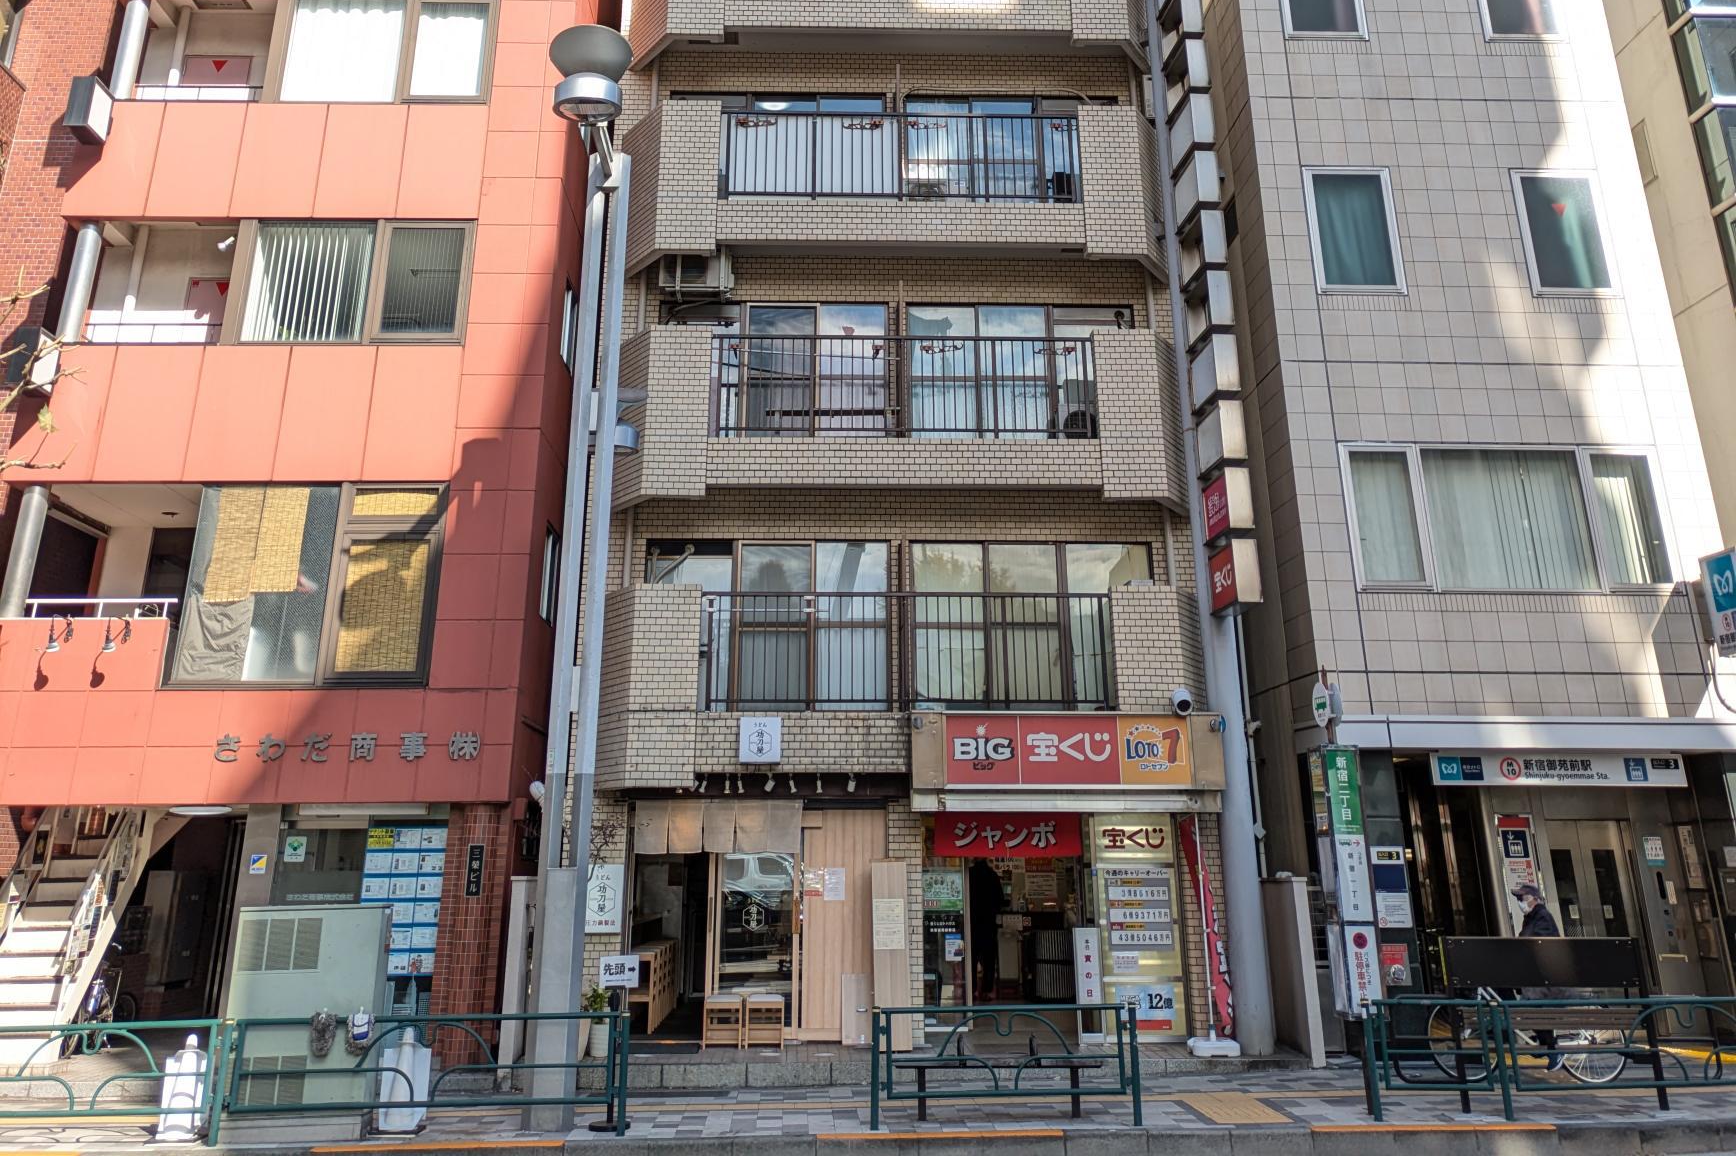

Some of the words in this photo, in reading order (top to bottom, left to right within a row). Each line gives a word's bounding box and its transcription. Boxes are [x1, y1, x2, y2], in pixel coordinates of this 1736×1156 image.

[756, 730, 765, 754] 功刀屋
[953, 735, 1015, 761] BIG
[1027, 732, 1111, 762] 宝くじ
[1126, 738, 1159, 760] LOTO
[1161, 728, 1180, 764] 7
[972, 761, 996, 771] ビッグ
[1140, 763, 1169, 771] ロトセブン
[1523, 758, 1592, 772] 新宿御苑前駅
[1667, 759, 1675, 769] 3
[1525, 771, 1594, 781] Shinjuku-gyoemmae
[1335, 756, 1352, 821] 新宿二丁目
[954, 820, 1056, 849] ジャンボ
[1102, 827, 1165, 849] 宝くじ
[1391, 851, 1397, 860] 3
[603, 963, 626, 976] 先頭
[1147, 993, 1173, 1010] 12億
